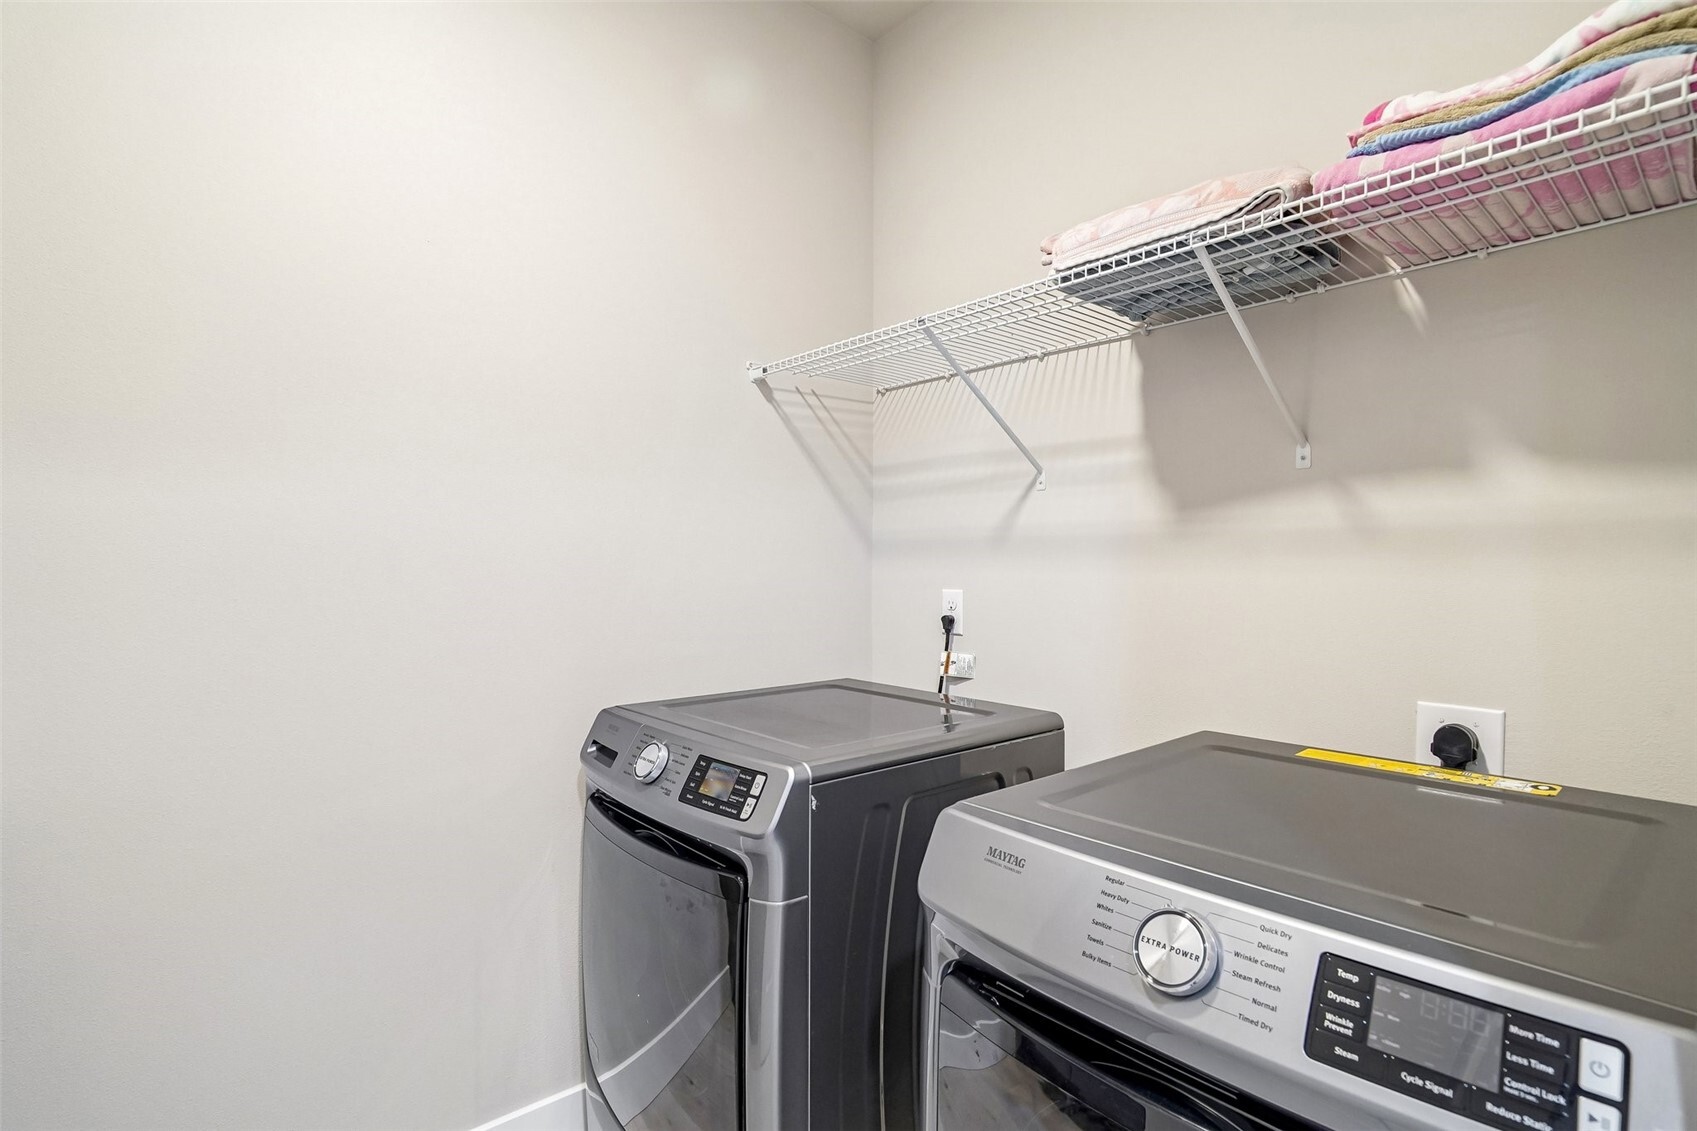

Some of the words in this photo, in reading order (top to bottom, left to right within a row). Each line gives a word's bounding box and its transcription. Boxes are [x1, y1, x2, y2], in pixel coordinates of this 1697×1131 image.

[986, 846, 1026, 868] MAYTAG
[1105, 875, 1125, 886] Regular
[1101, 889, 1118, 901] Heavy
[1116, 894, 1130, 905] Duty
[1096, 902, 1114, 914] Whites
[1091, 918, 1112, 930] Sanitize
[1259, 924, 1278, 935] Quick
[1280, 930, 1292, 941] Dry
[1087, 934, 1104, 946] Towels
[1140, 935, 1167, 950] EXTRA
[1169, 945, 1201, 962] POWER
[1257, 941, 1289, 957] Delicates
[1081, 950, 1097, 962] Bulky
[1097, 955, 1111, 967] Items
[1234, 950, 1259, 964] Wrinkle
[1259, 960, 1285, 973] Control
[1232, 970, 1253, 983] Steam
[1254, 977, 1281, 992] Refresh
[1337, 968, 1359, 983] Temp
[1251, 998, 1277, 1012] Normal
[1327, 990, 1360, 1008] Dryness
[1238, 1013, 1259, 1026] Timed
[1260, 1021, 1273, 1032] Dry
[1324, 1020, 1353, 1036] Prevent
[1325, 1012, 1354, 1029] Wrinkle
[1509, 1024, 1534, 1040] More
[1534, 1032, 1560, 1048] Time
[1334, 1046, 1359, 1062] Steam
[1506, 1051, 1529, 1066] Less
[1529, 1058, 1555, 1075] Time
[1400, 1071, 1424, 1087] Cycle
[1424, 1080, 1453, 1098] Signal
[1503, 1076, 1540, 1097] Control
[1541, 1088, 1567, 1106] Lock
[1486, 1101, 1522, 1123] Reduce
[1522, 1115, 1553, 1131] Static
